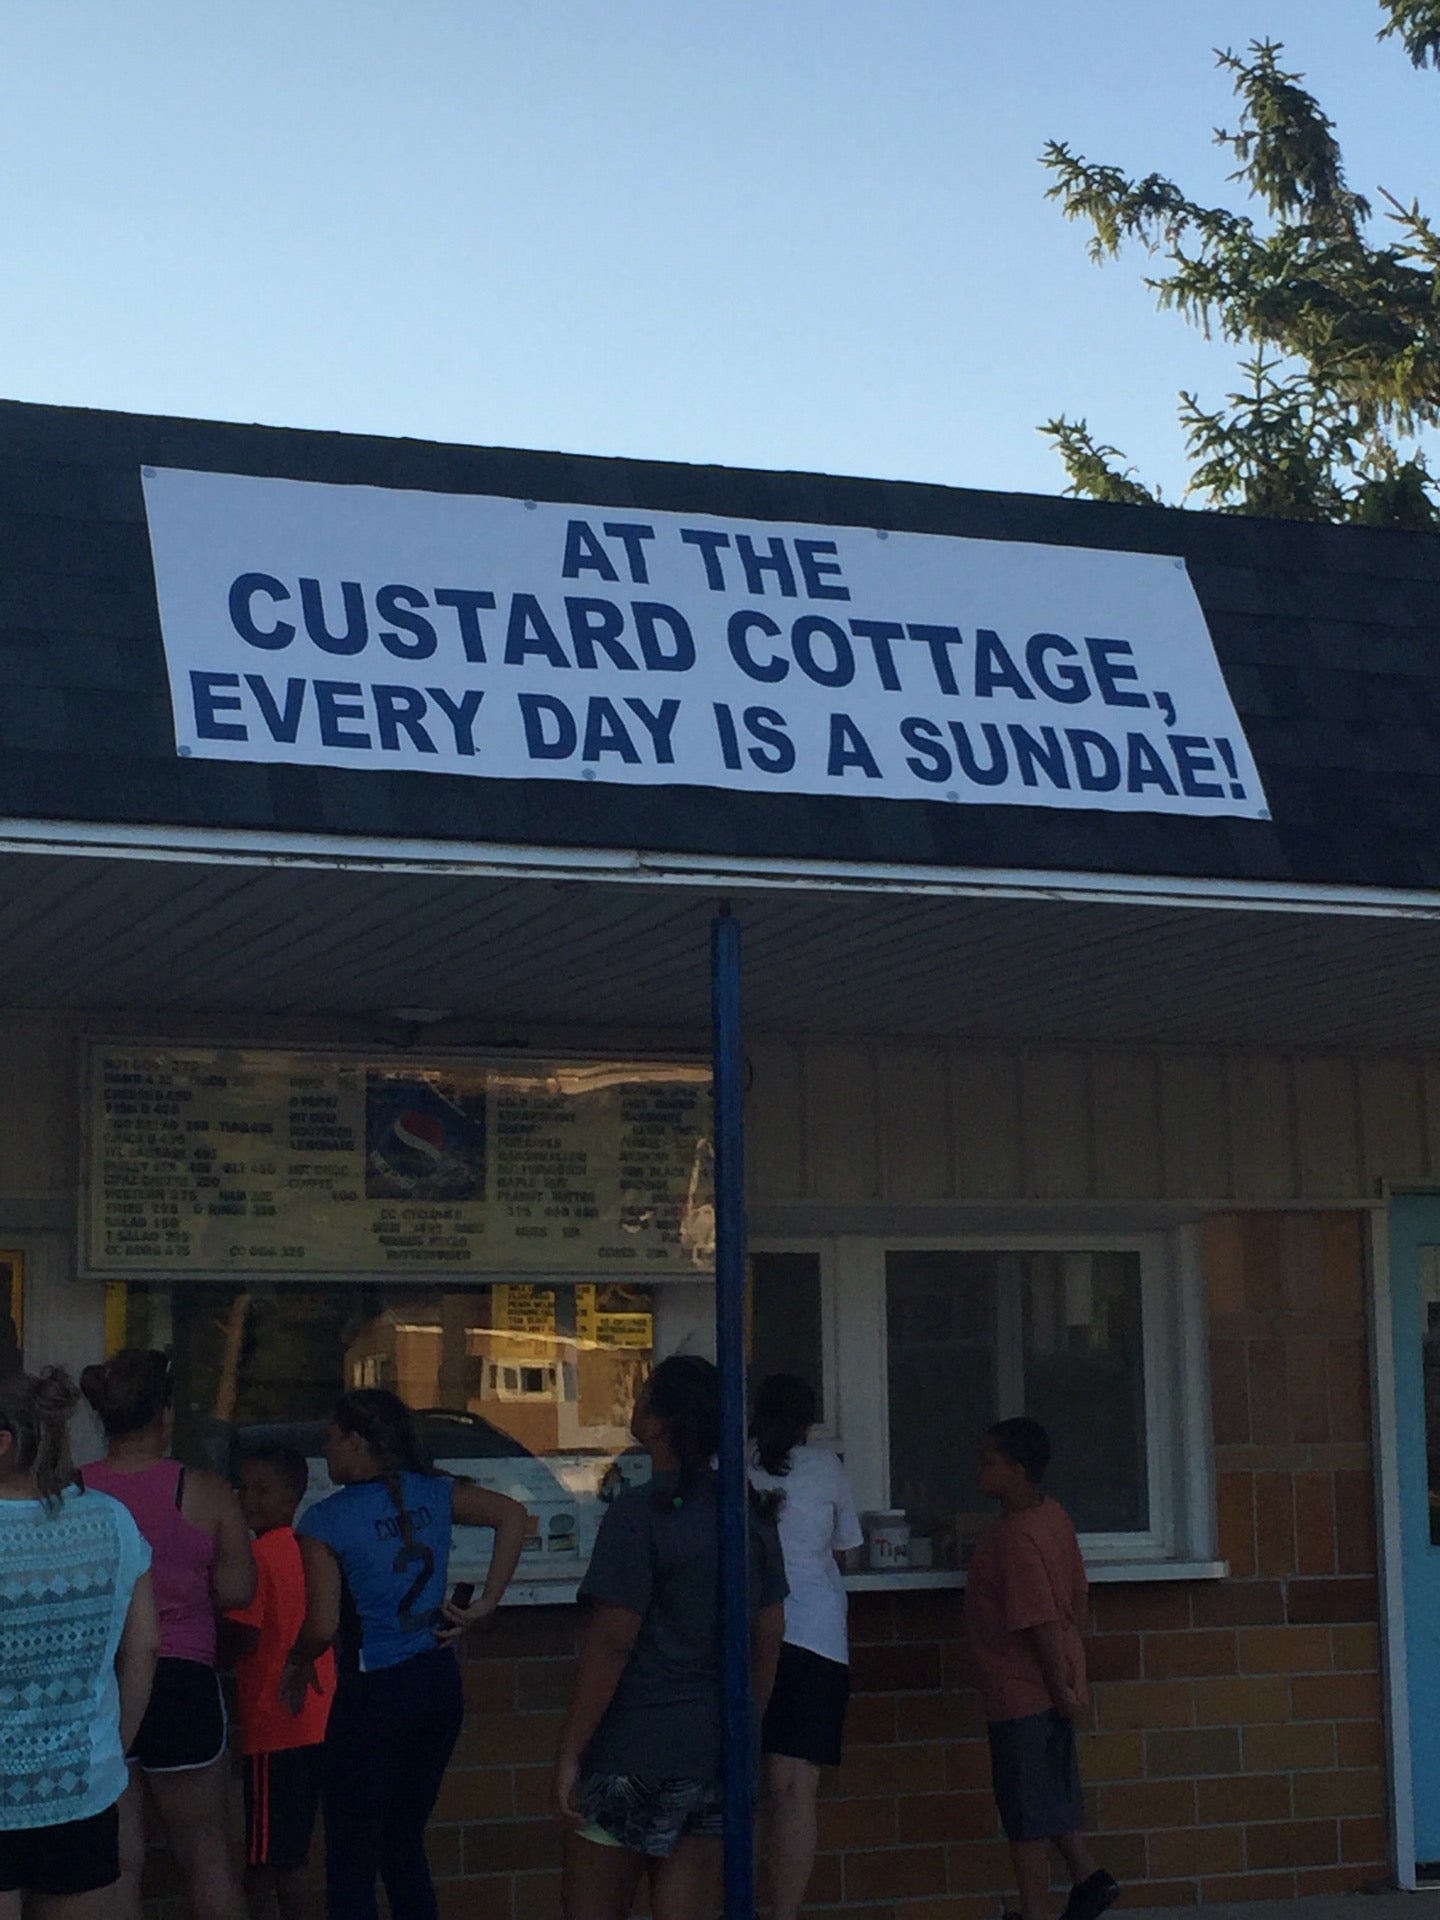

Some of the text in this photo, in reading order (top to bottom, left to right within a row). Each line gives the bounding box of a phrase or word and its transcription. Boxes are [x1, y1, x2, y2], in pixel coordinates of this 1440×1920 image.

[562, 520, 851, 601] AT THE
[228, 572, 1176, 727] CUSTARD COTTAGE,
[189, 670, 1247, 800] EVERY DAY IS A SUNDAE!
